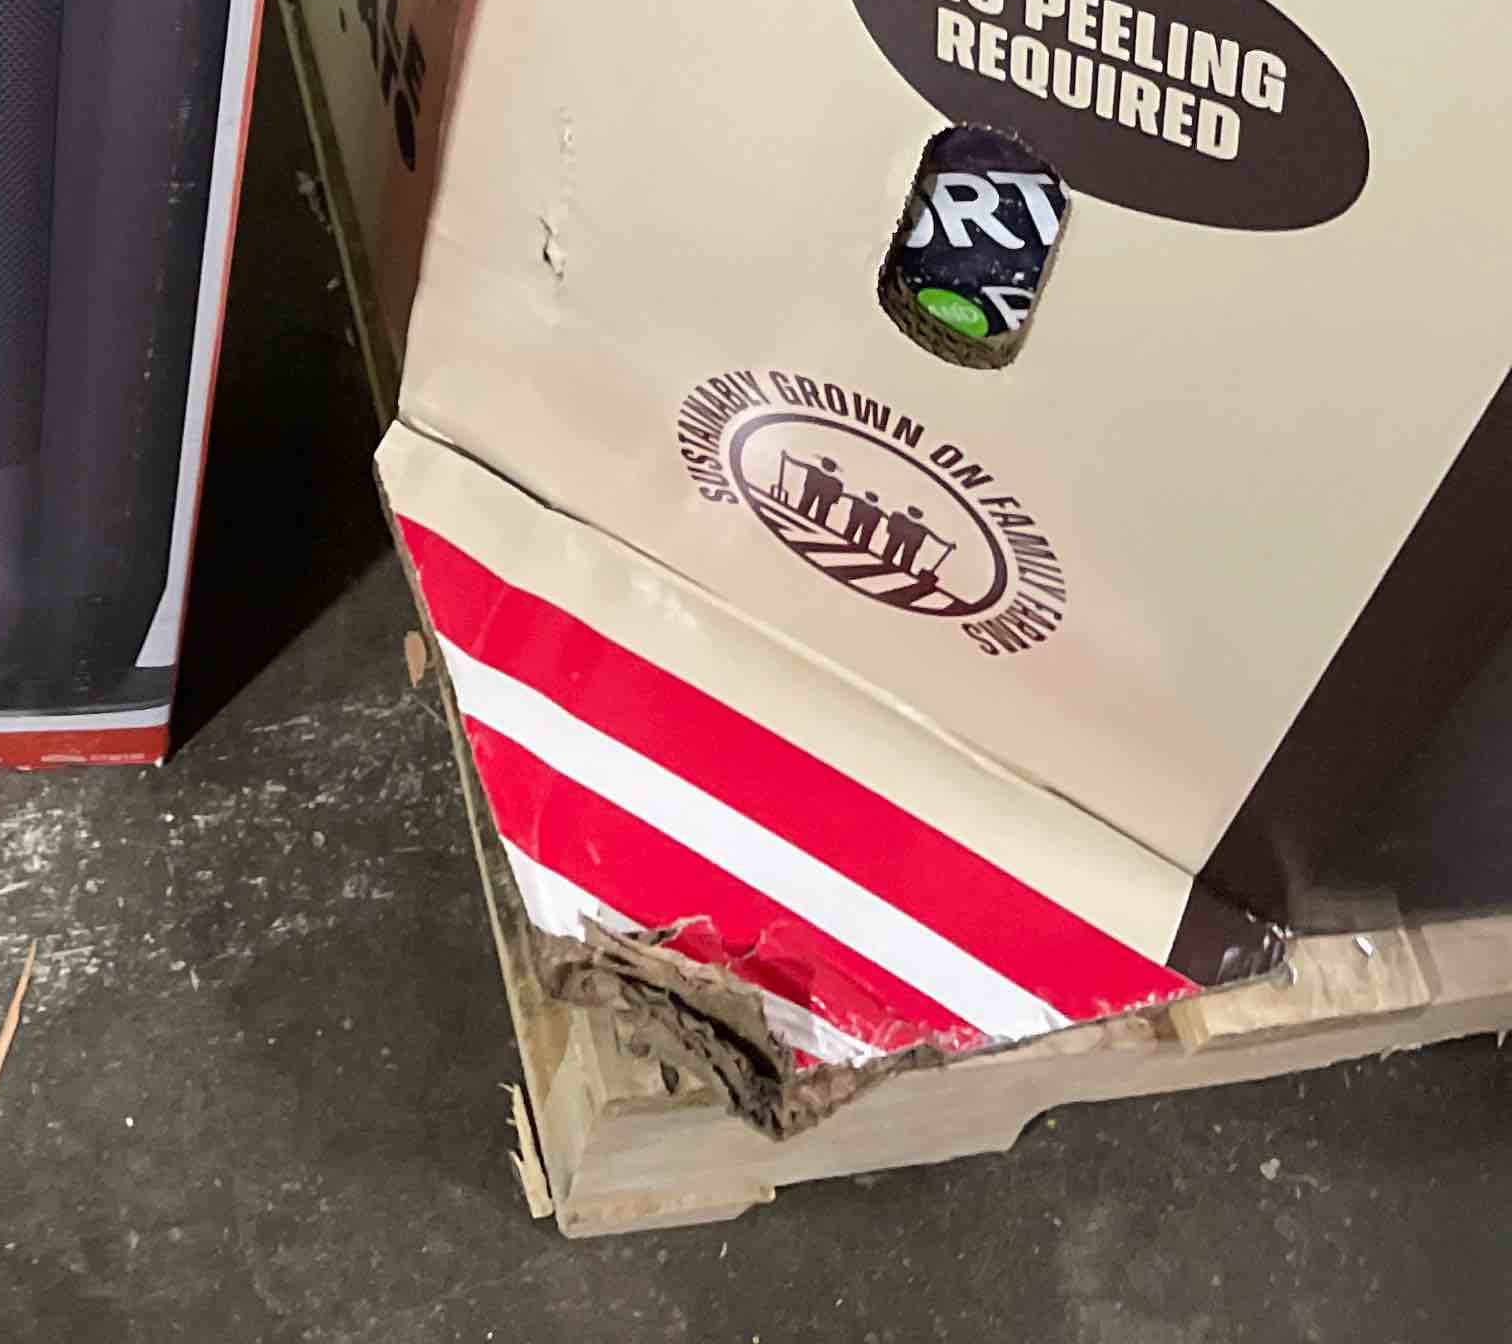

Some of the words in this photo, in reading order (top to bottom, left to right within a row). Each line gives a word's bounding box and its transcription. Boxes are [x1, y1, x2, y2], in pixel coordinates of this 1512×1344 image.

[936, 6, 1241, 161] REQUIRED
[677, 369, 770, 505] SUSTAINABLY
[768, 369, 925, 450] GROWN
[929, 443, 995, 490] ON
[979, 495, 1068, 603] FAMILY
[960, 600, 1063, 657] FARMS
